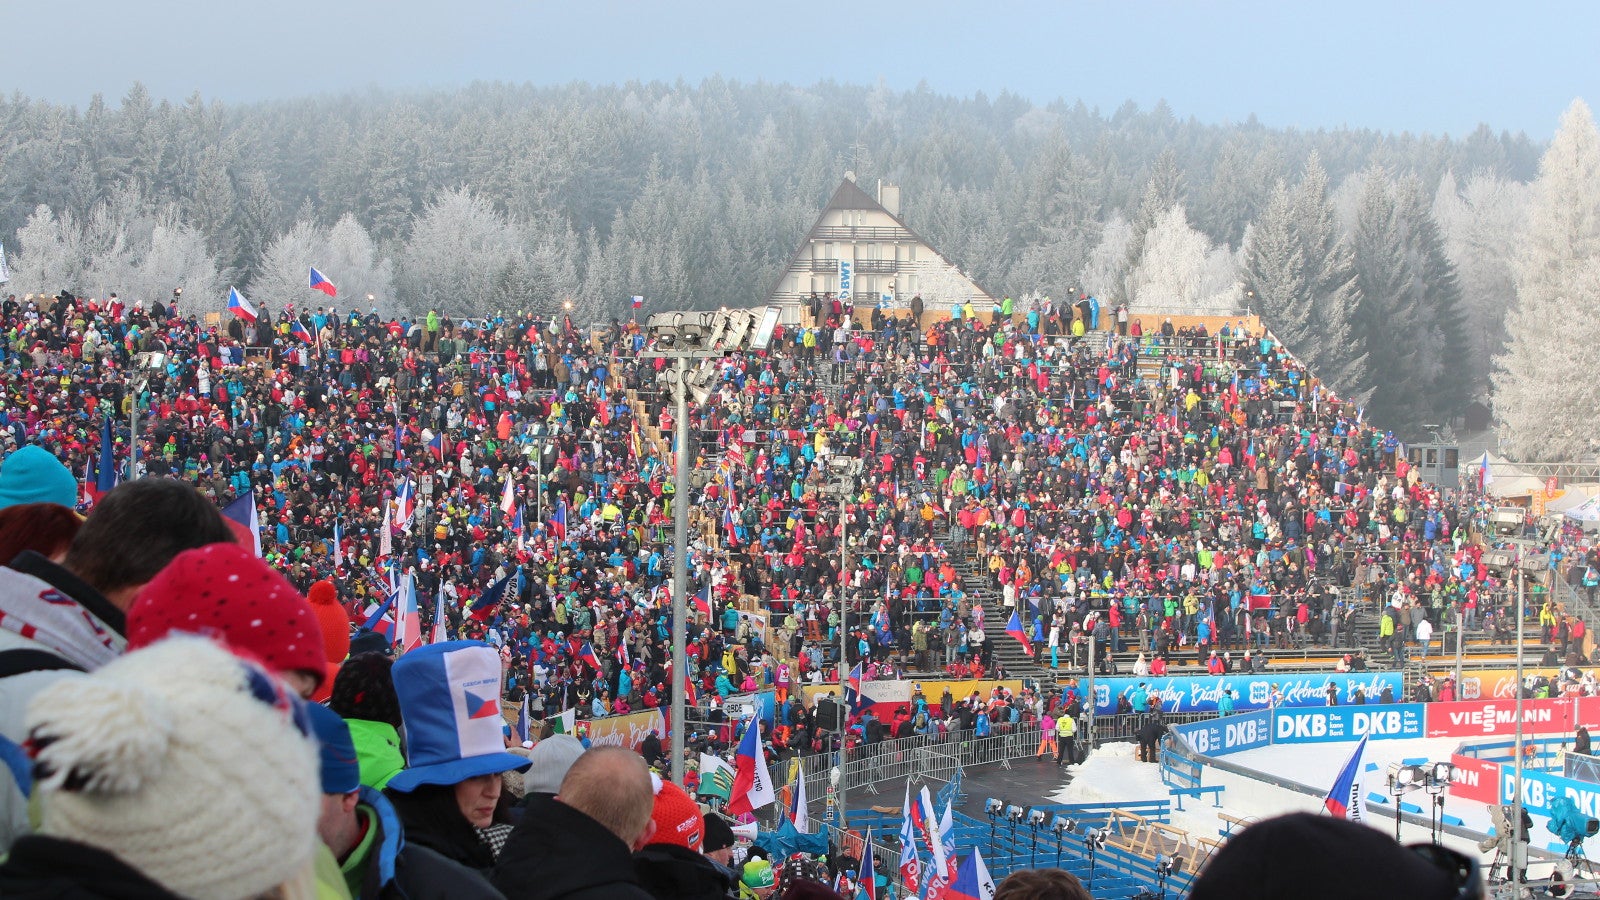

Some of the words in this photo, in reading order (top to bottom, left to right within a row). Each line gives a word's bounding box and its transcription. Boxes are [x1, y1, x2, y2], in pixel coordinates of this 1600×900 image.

[841, 261, 850, 289] BWT
[1225, 720, 1257, 748] DKB
[1277, 714, 1327, 738] DKB
[1353, 711, 1401, 736] DKB
